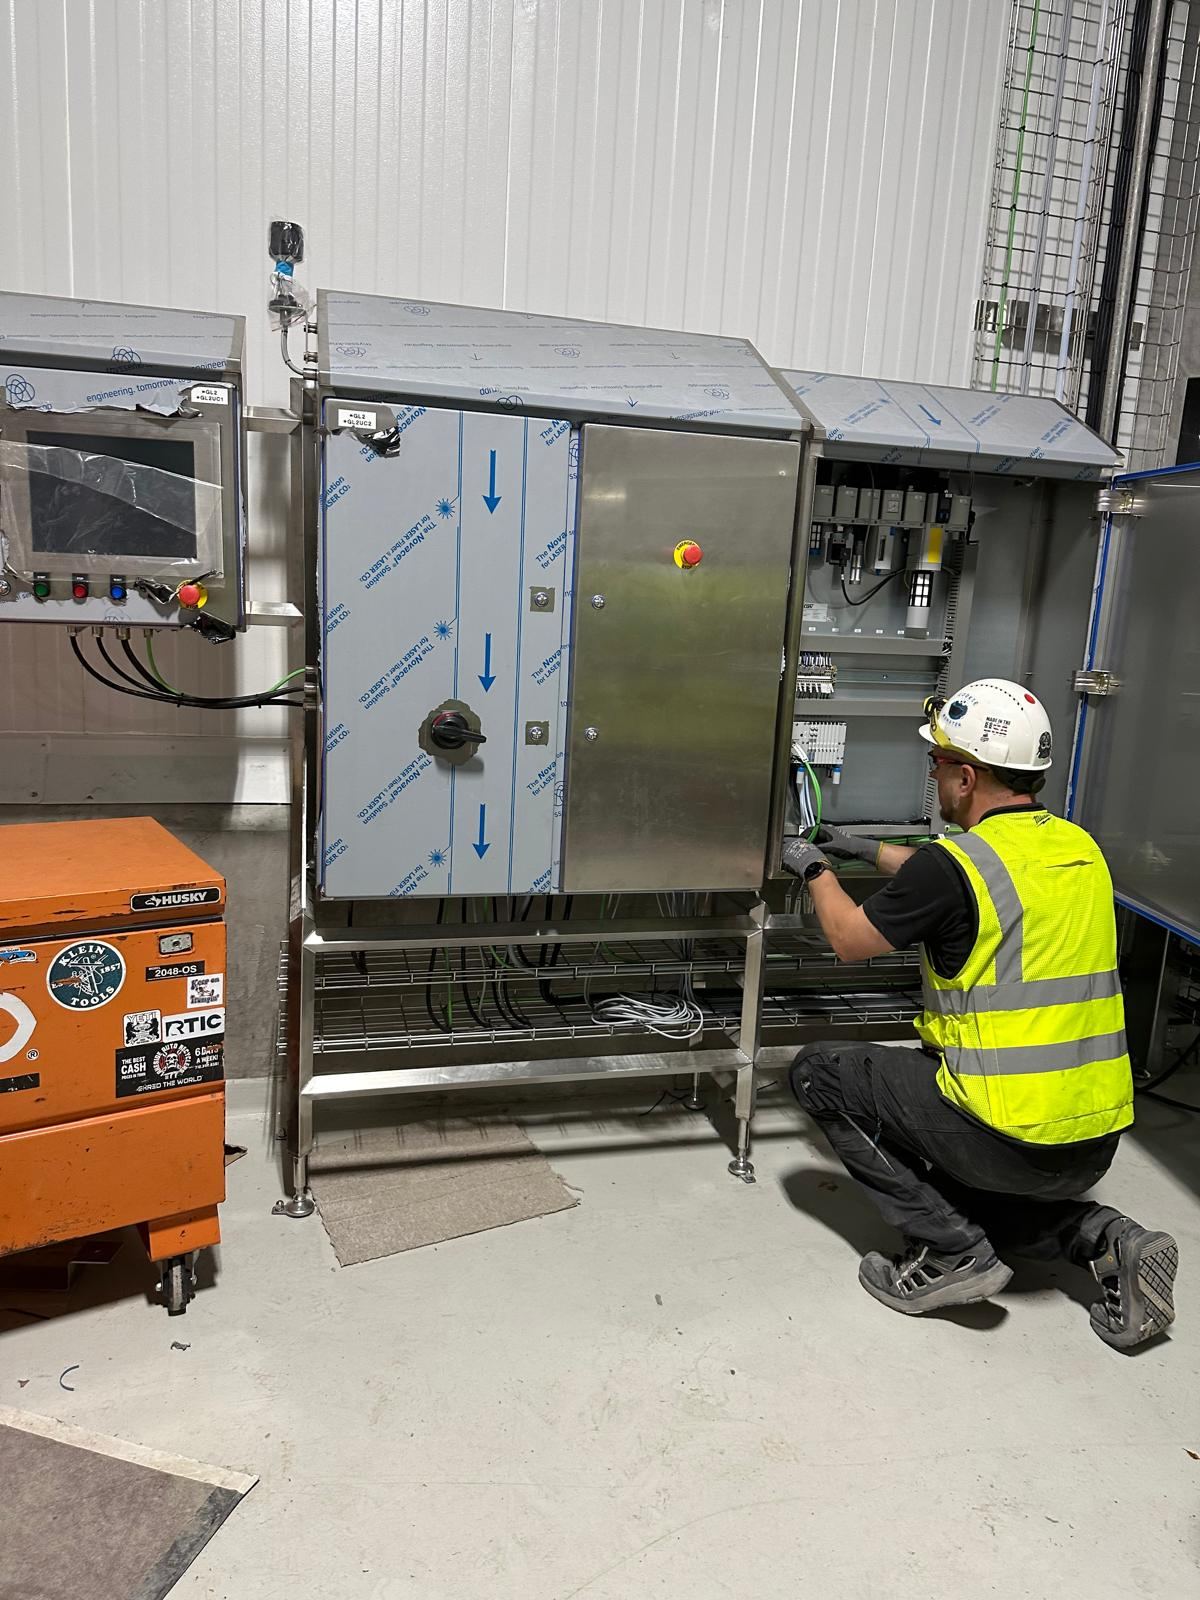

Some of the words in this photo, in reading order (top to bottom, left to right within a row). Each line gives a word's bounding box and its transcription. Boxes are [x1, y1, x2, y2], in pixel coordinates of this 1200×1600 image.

[87, 388, 135, 402] engineering.
[137, 379, 177, 392] tomorrow.
[540, 427, 554, 439] The
[545, 437, 555, 447] for
[420, 514, 431, 524] for
[403, 522, 422, 540] LASER
[423, 521, 437, 533] The
[390, 539, 406, 553] Fiber
[536, 551, 549, 562] The
[369, 555, 389, 574] LASER
[541, 560, 550, 569] for
[365, 564, 392, 589] Solution
[419, 636, 429, 646] for
[402, 644, 421, 662] LASER
[421, 643, 435, 655] The
[389, 660, 405, 675] Fiber
[531, 667, 544, 679] The
[368, 676, 388, 695] LASER
[536, 676, 545, 685] for
[364, 685, 391, 710] Solution
[417, 752, 427, 762] for
[400, 759, 419, 778] LASER
[419, 759, 433, 771] The
[387, 776, 402, 790] Fiber
[527, 779, 539, 790] The
[532, 787, 540, 796] for
[367, 791, 386, 810] LASER
[362, 800, 388, 825] Solution
[411, 864, 423, 875] for
[415, 870, 430, 882] The
[395, 872, 415, 889] LASER
[162, 891, 207, 905] HUSKY
[59, 945, 106, 967] KLEIN
[100, 962, 121, 974] 1857
[155, 965, 197, 978] 2048-OS
[71, 986, 114, 1006] TOOLS
[165, 1013, 222, 1037] RTIC
[195, 1047, 201, 1057] 6
[121, 1062, 146, 1075] CASH
[163, 1080, 175, 1088] THE
[177, 1075, 203, 1085] WORLD
